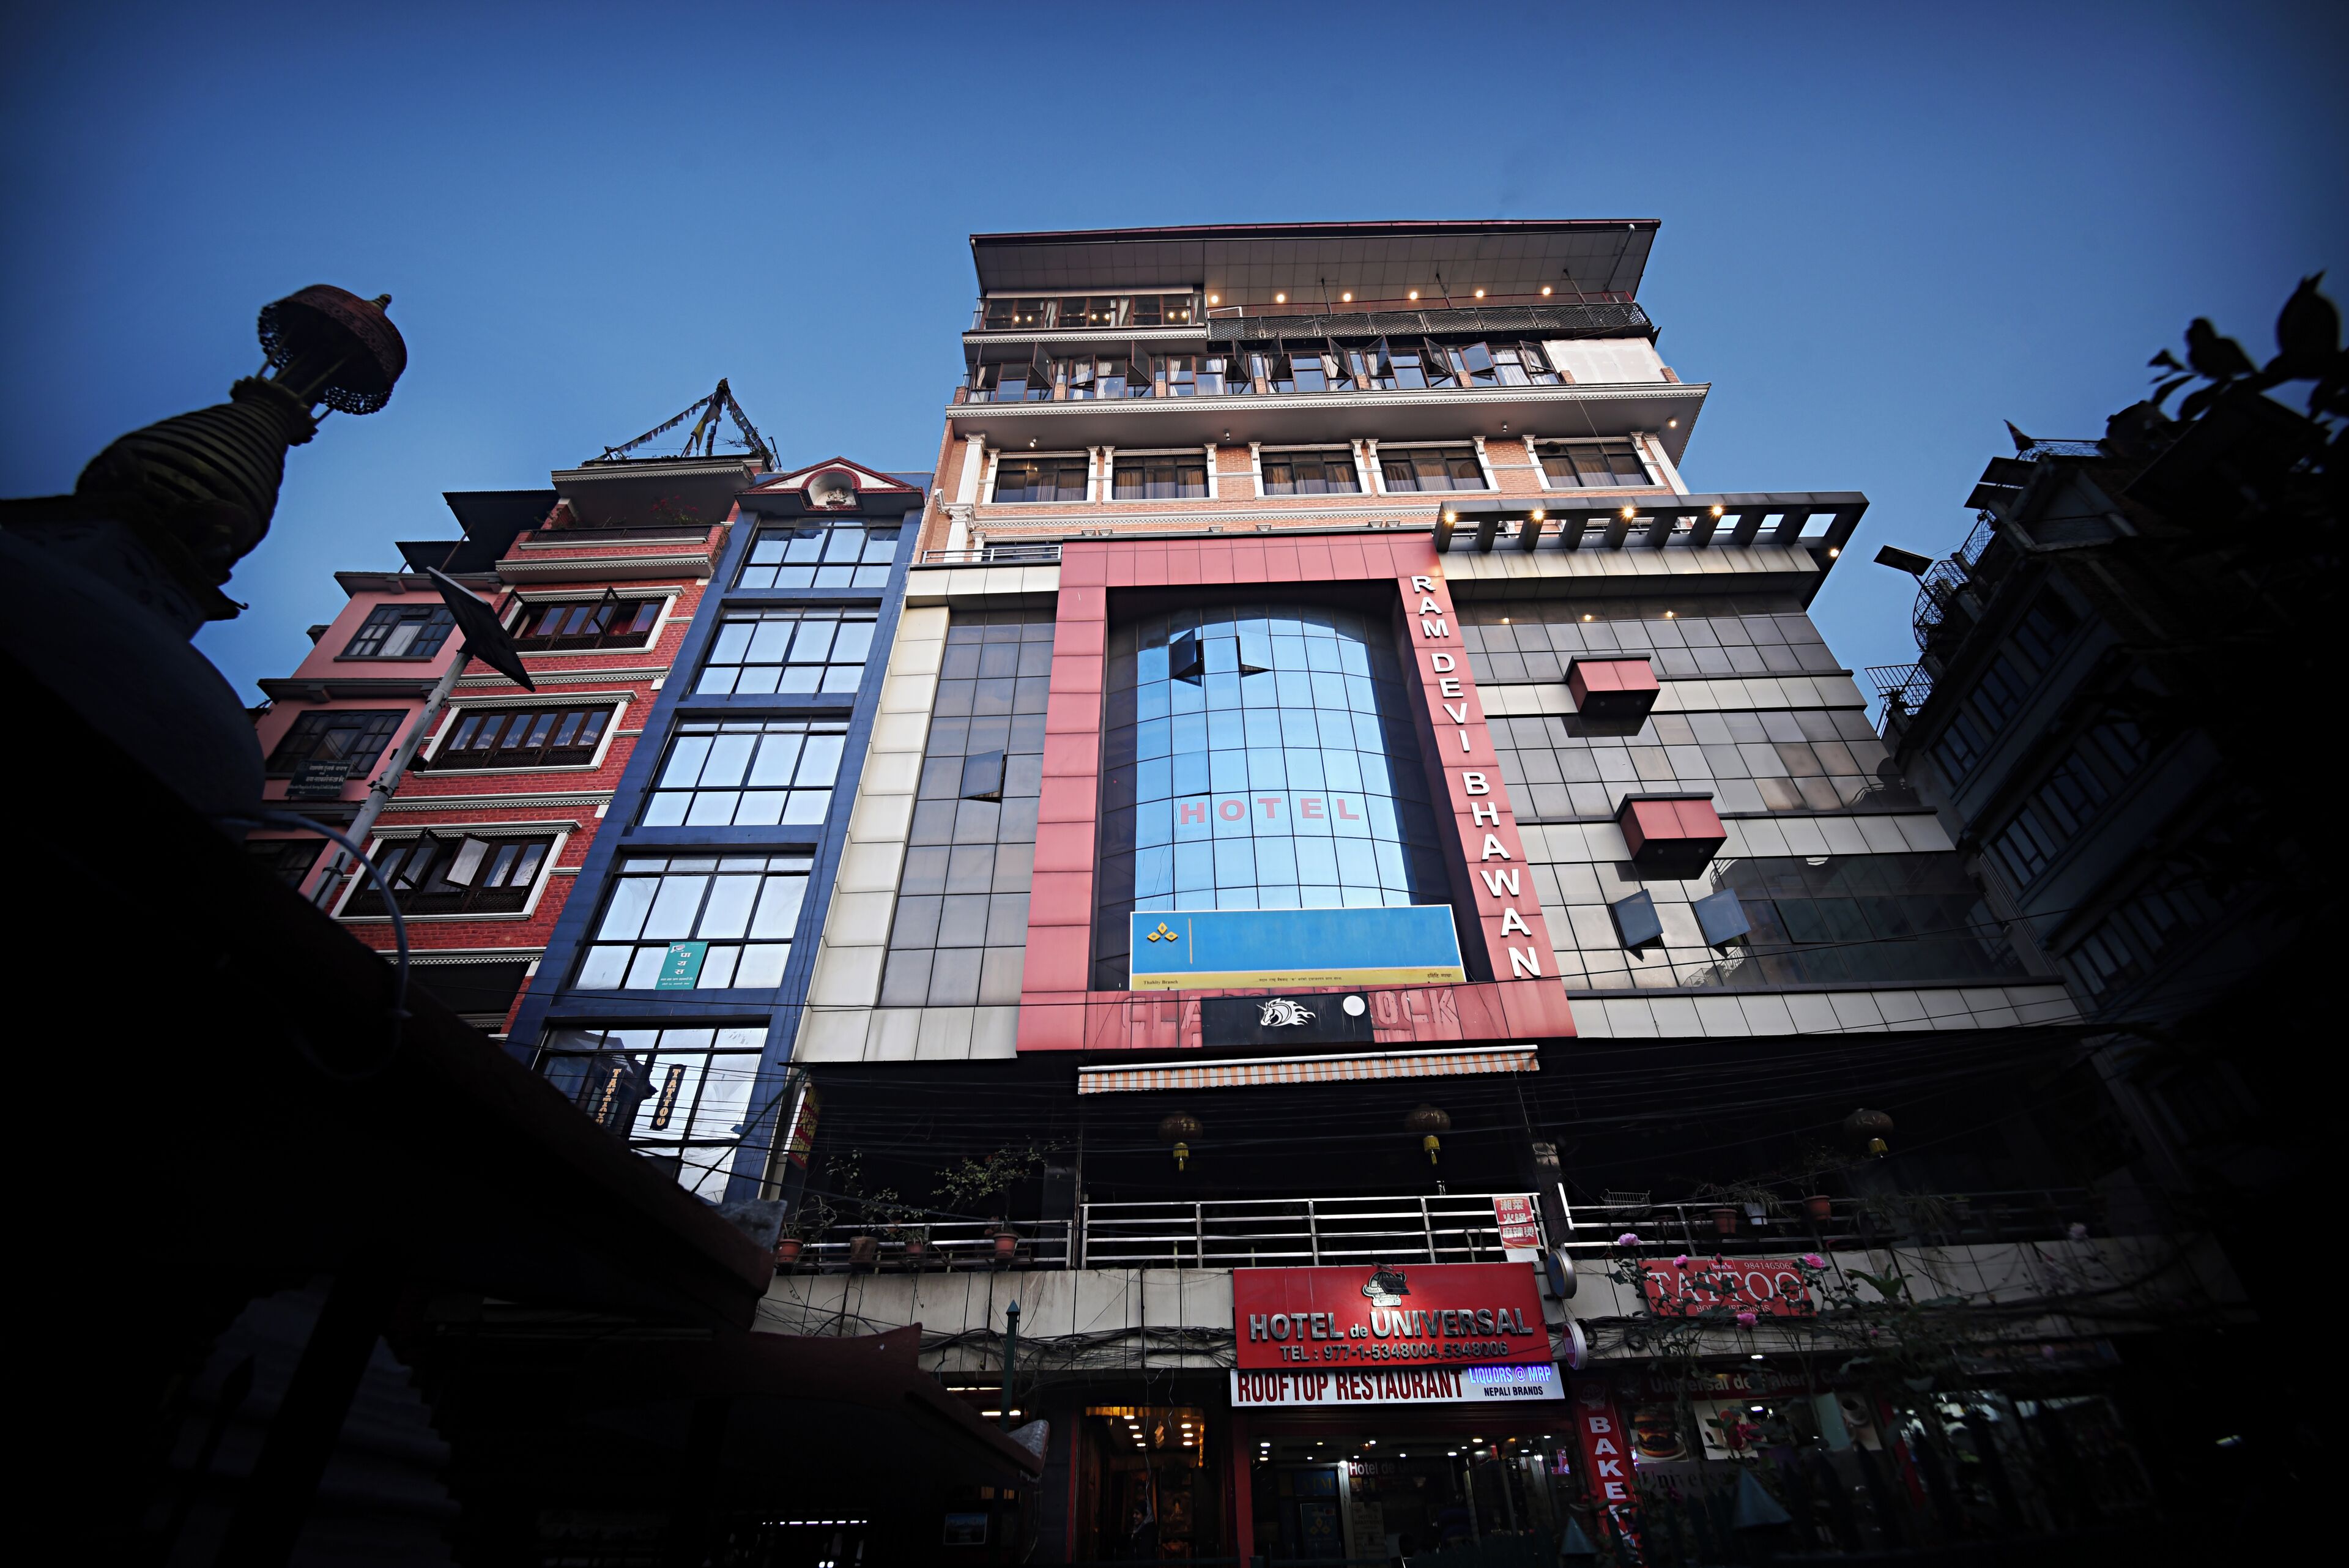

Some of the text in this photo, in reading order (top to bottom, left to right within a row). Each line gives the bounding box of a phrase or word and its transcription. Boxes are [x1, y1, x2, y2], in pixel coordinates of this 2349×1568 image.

[1411, 576, 1541, 978] RAM DEVI BHAWAN
[1180, 797, 1360, 825] HOTEL
[1368, 989, 1461, 1024] OCK
[656, 1068, 682, 1126] TATTOO
[1500, 1199, 1524, 1211] 湘菜
[1502, 1213, 1527, 1224] 火锅
[1502, 1226, 1535, 1239] 麻辣烫
[1250, 1308, 1533, 1341] HOTEL de UNIVERSAL
[1468, 1366, 1552, 1384] LIQUORS @ MRP
[1238, 1369, 1463, 1402] ROOFTOP RESTAURANT
[1484, 1386, 1543, 1397] NEPALI BRANDS
[1349, 1462, 1378, 1476] Hotel
[1301, 1477, 1332, 1489] ATM
